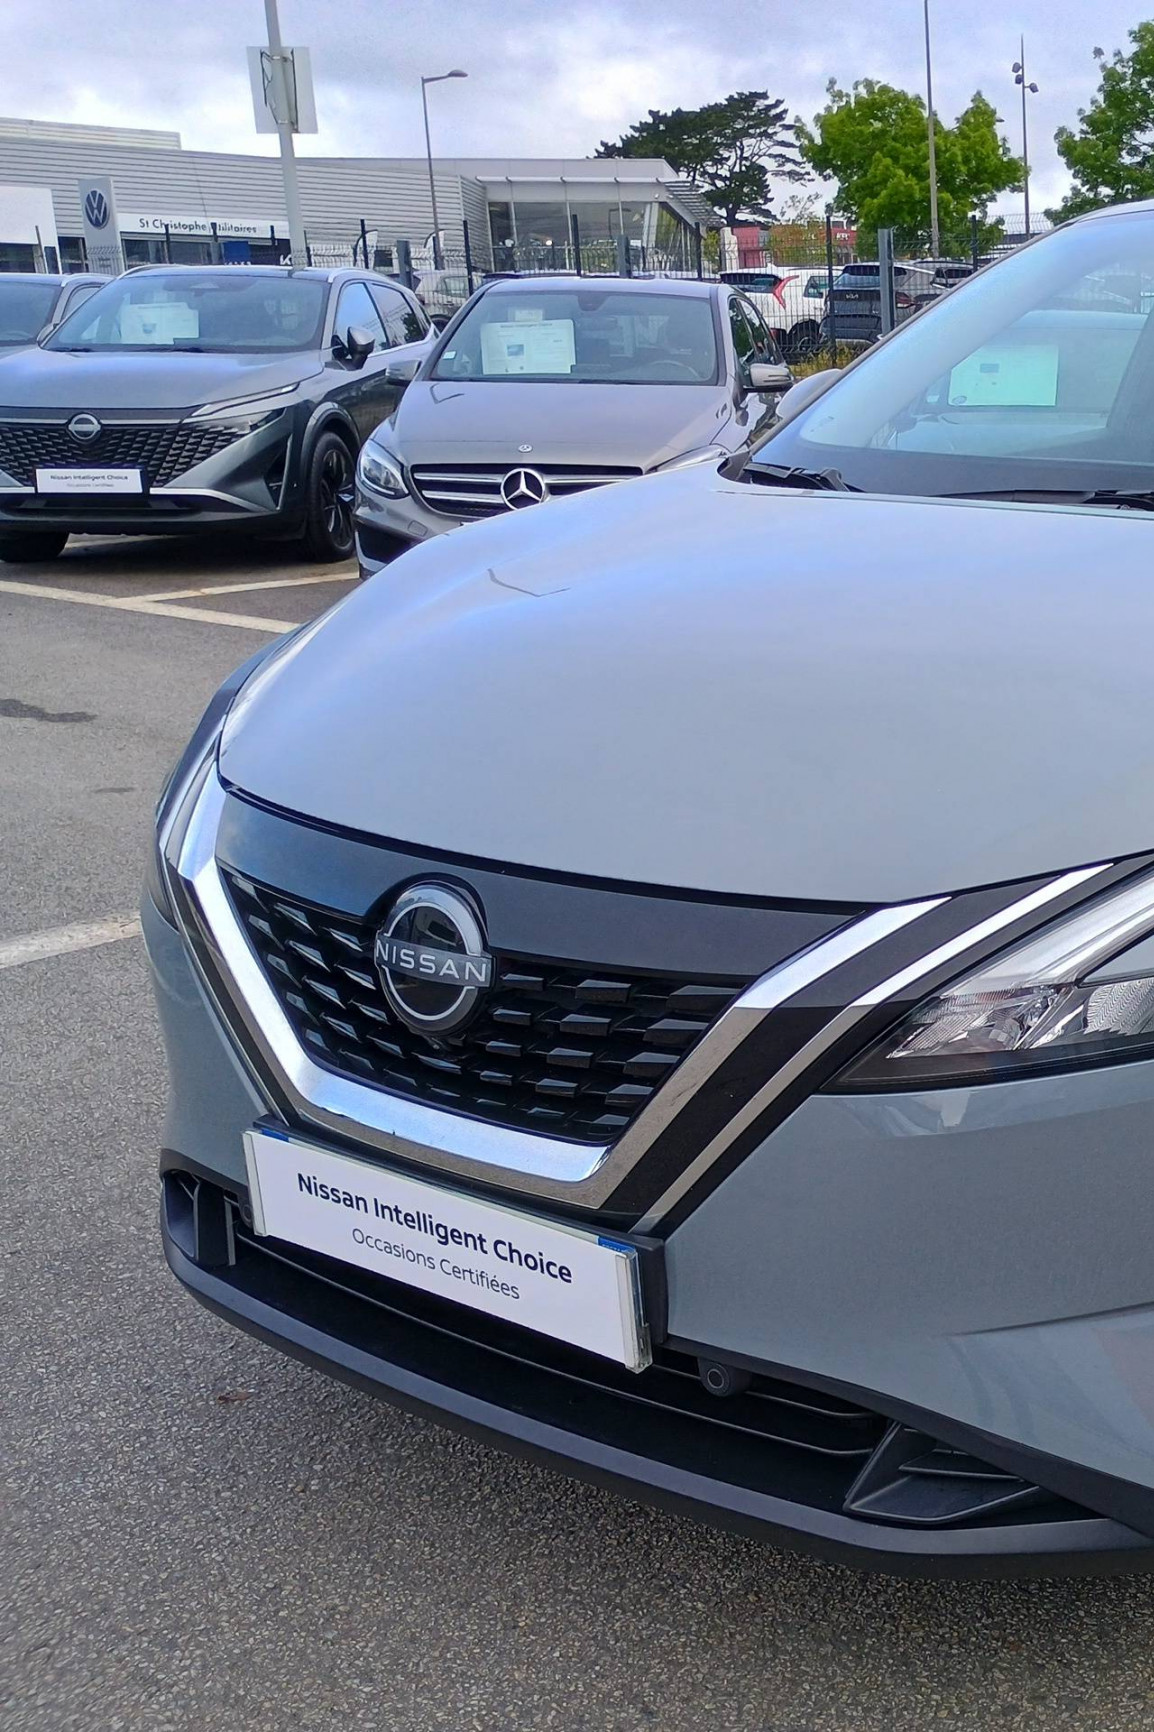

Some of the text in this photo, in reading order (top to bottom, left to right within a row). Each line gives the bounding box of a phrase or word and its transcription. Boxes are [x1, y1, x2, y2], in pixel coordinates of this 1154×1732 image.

[139, 218, 257, 233] St Chistophe tilitaires
[375, 938, 487, 982] NISSAN
[297, 1172, 572, 1284] Nissan Intelligent Choice
[352, 1228, 520, 1300] Occasions Certifiées
